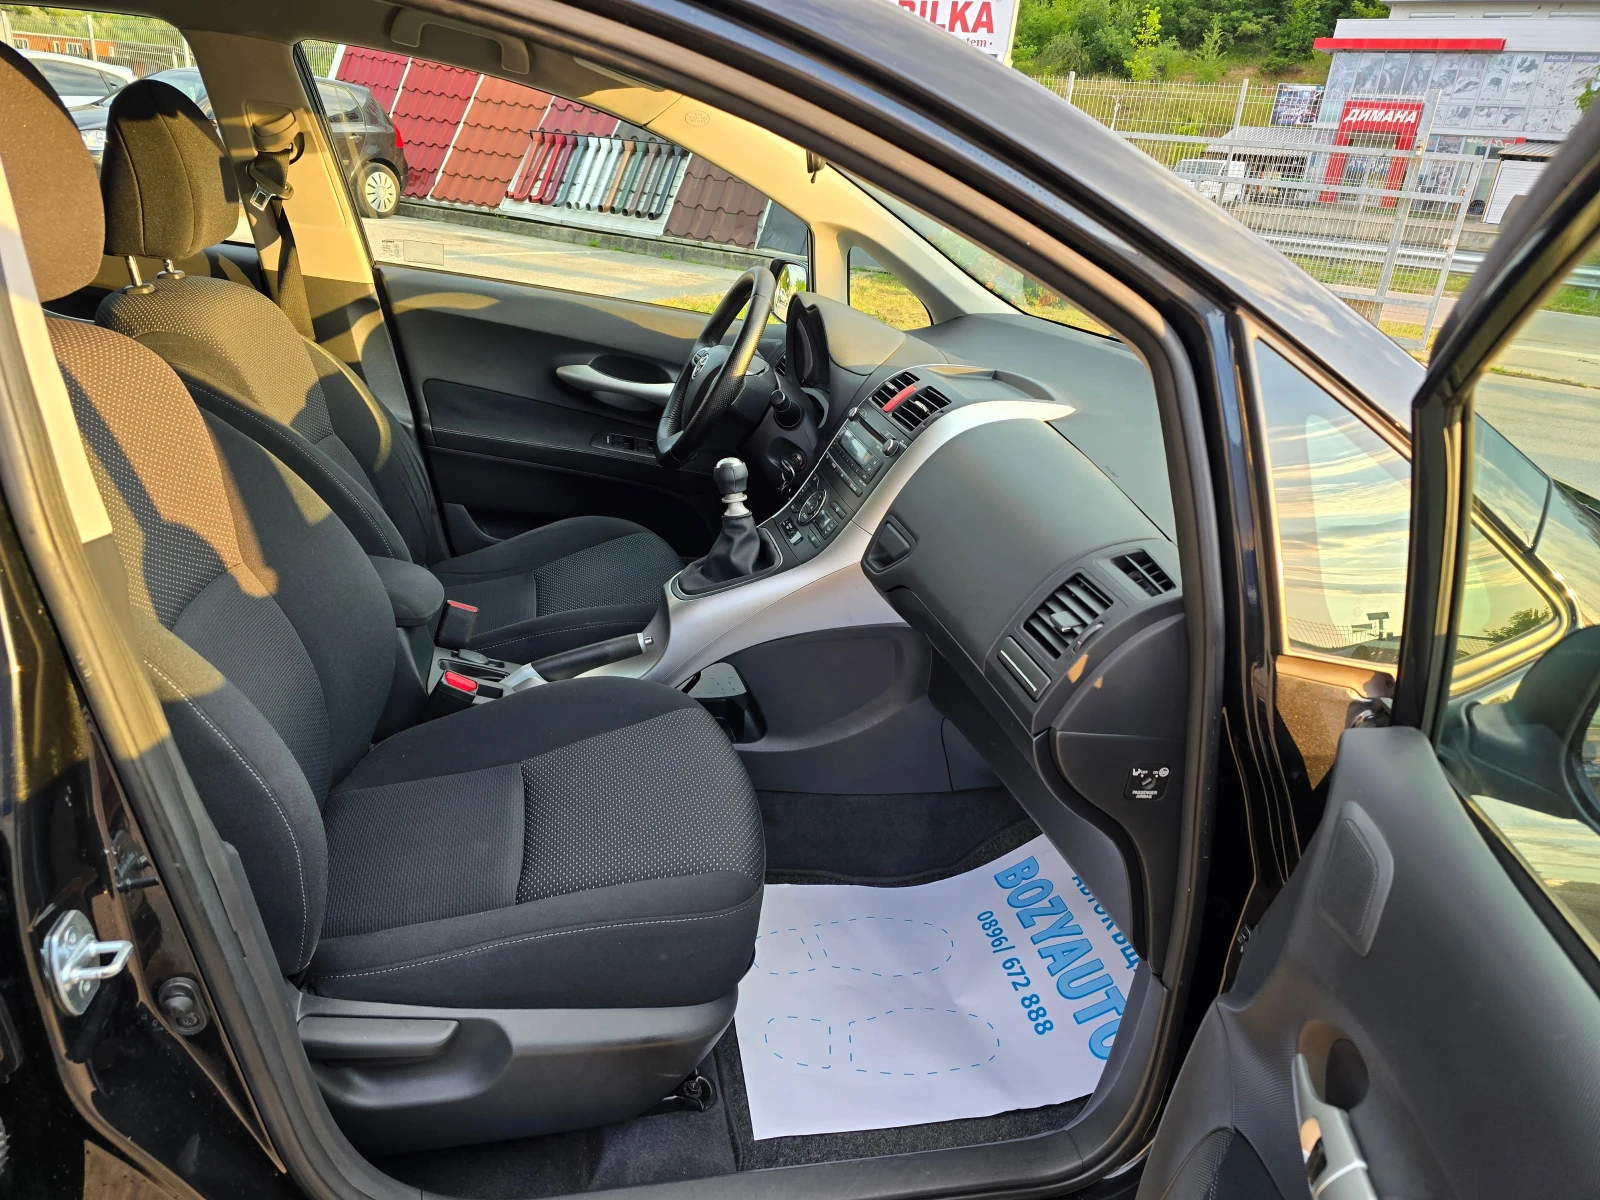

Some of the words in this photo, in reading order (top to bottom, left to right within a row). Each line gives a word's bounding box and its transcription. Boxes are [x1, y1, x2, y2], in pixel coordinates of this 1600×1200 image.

[1343, 108, 1418, 124] ДИМАНА
[977, 910, 1016, 953] 0896/
[1002, 957, 1031, 991] 672
[1021, 993, 1054, 1035] 888
[993, 856, 1127, 1060] BOZYAUTO
